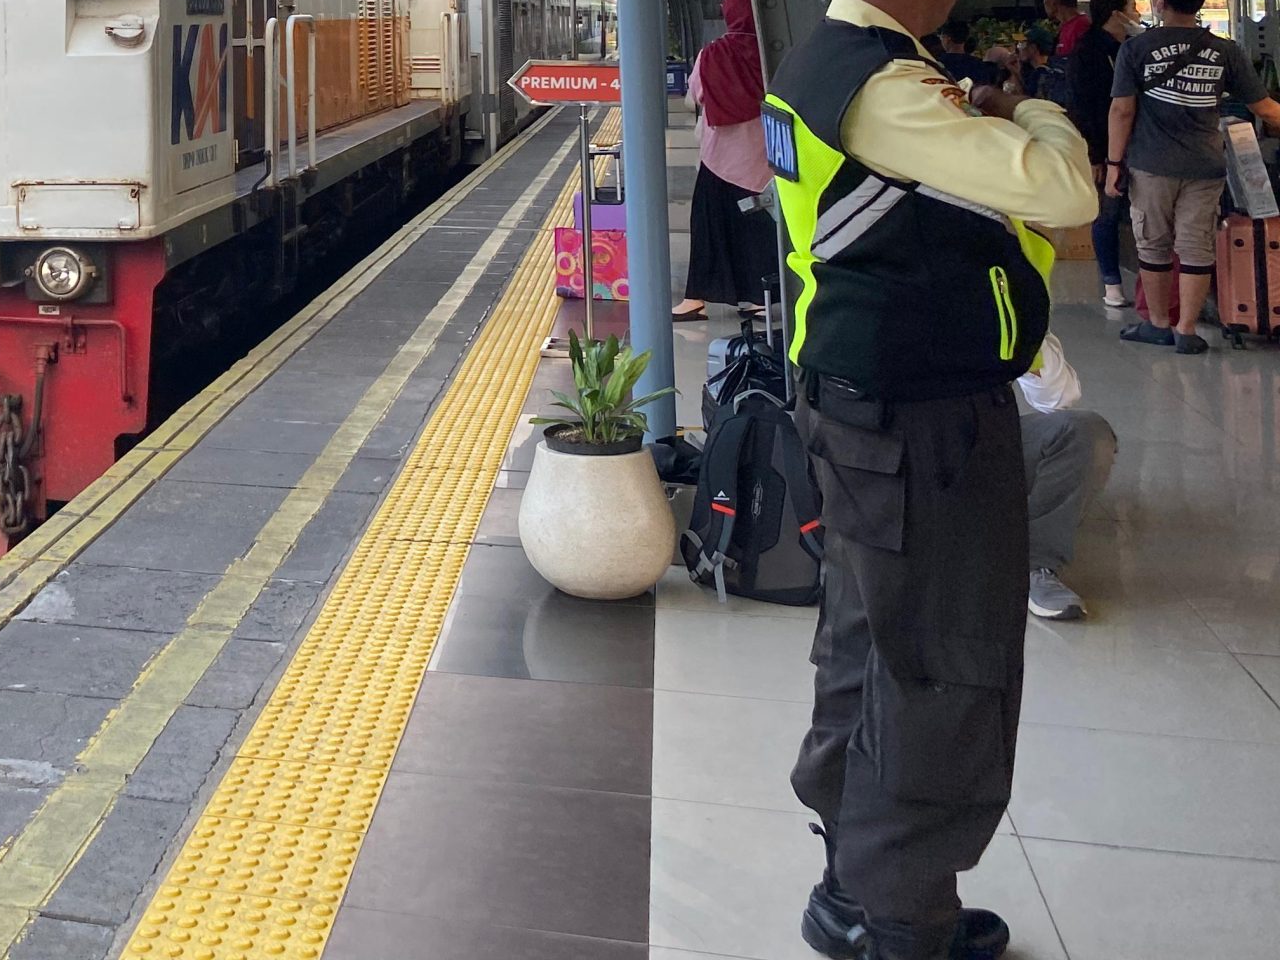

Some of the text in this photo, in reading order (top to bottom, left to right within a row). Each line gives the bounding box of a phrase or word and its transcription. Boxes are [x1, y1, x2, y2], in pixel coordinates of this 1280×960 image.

[1151, 43, 1191, 61] BREW
[1181, 66, 1220, 78] COFFEE
[171, 23, 227, 145] KAI
[521, 76, 598, 90] PREMIUM
